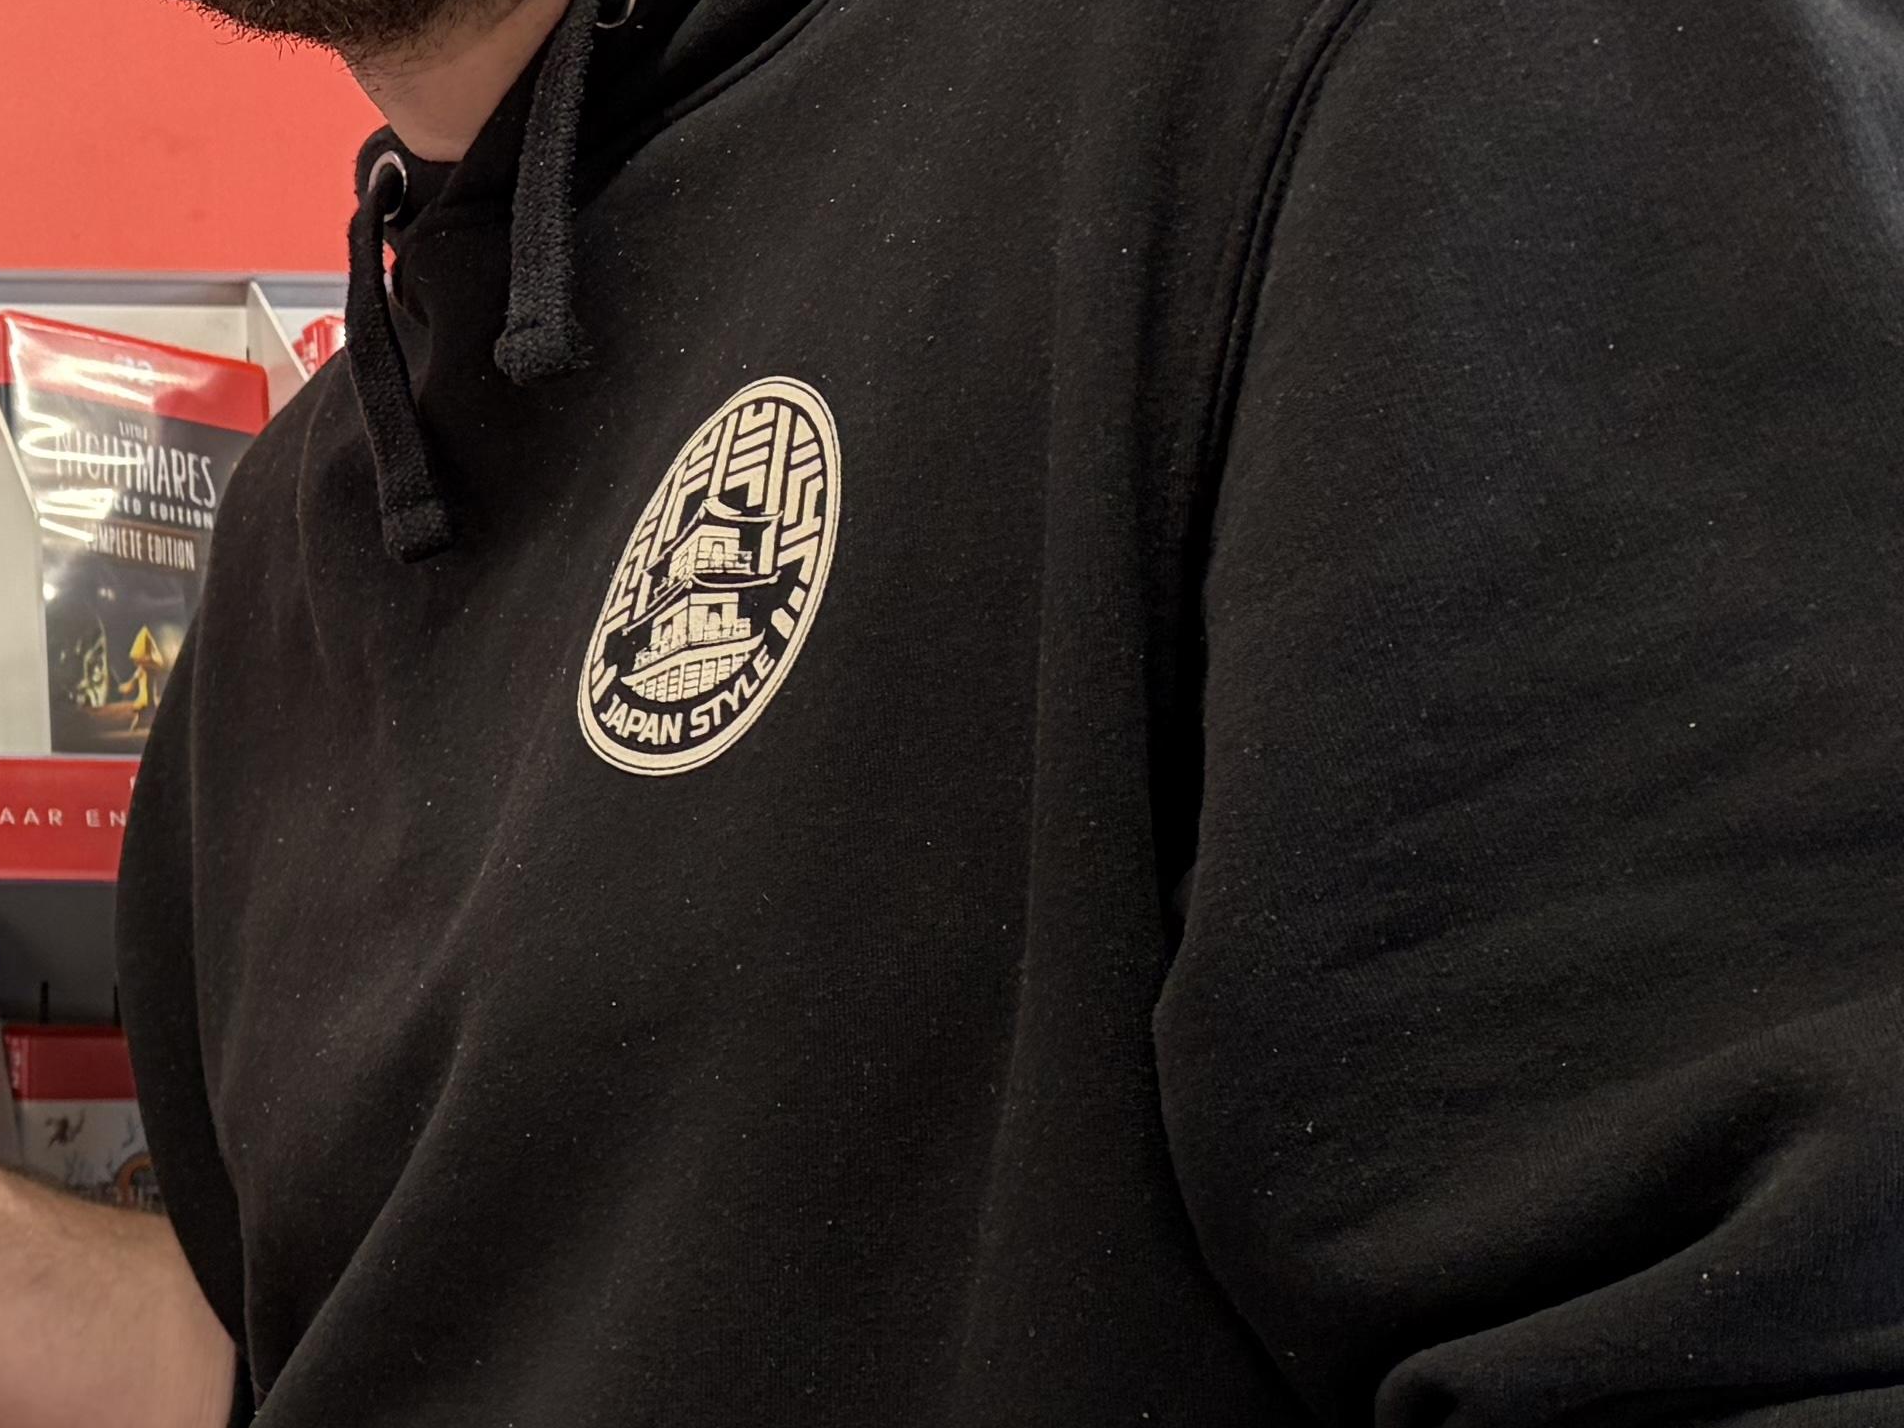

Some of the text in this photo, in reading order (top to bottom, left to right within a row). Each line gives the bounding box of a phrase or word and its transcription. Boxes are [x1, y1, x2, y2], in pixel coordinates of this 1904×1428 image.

[147, 532, 196, 571] EDITION
[598, 644, 777, 746] JAPAN STYLE
[86, 806, 127, 828] EN
